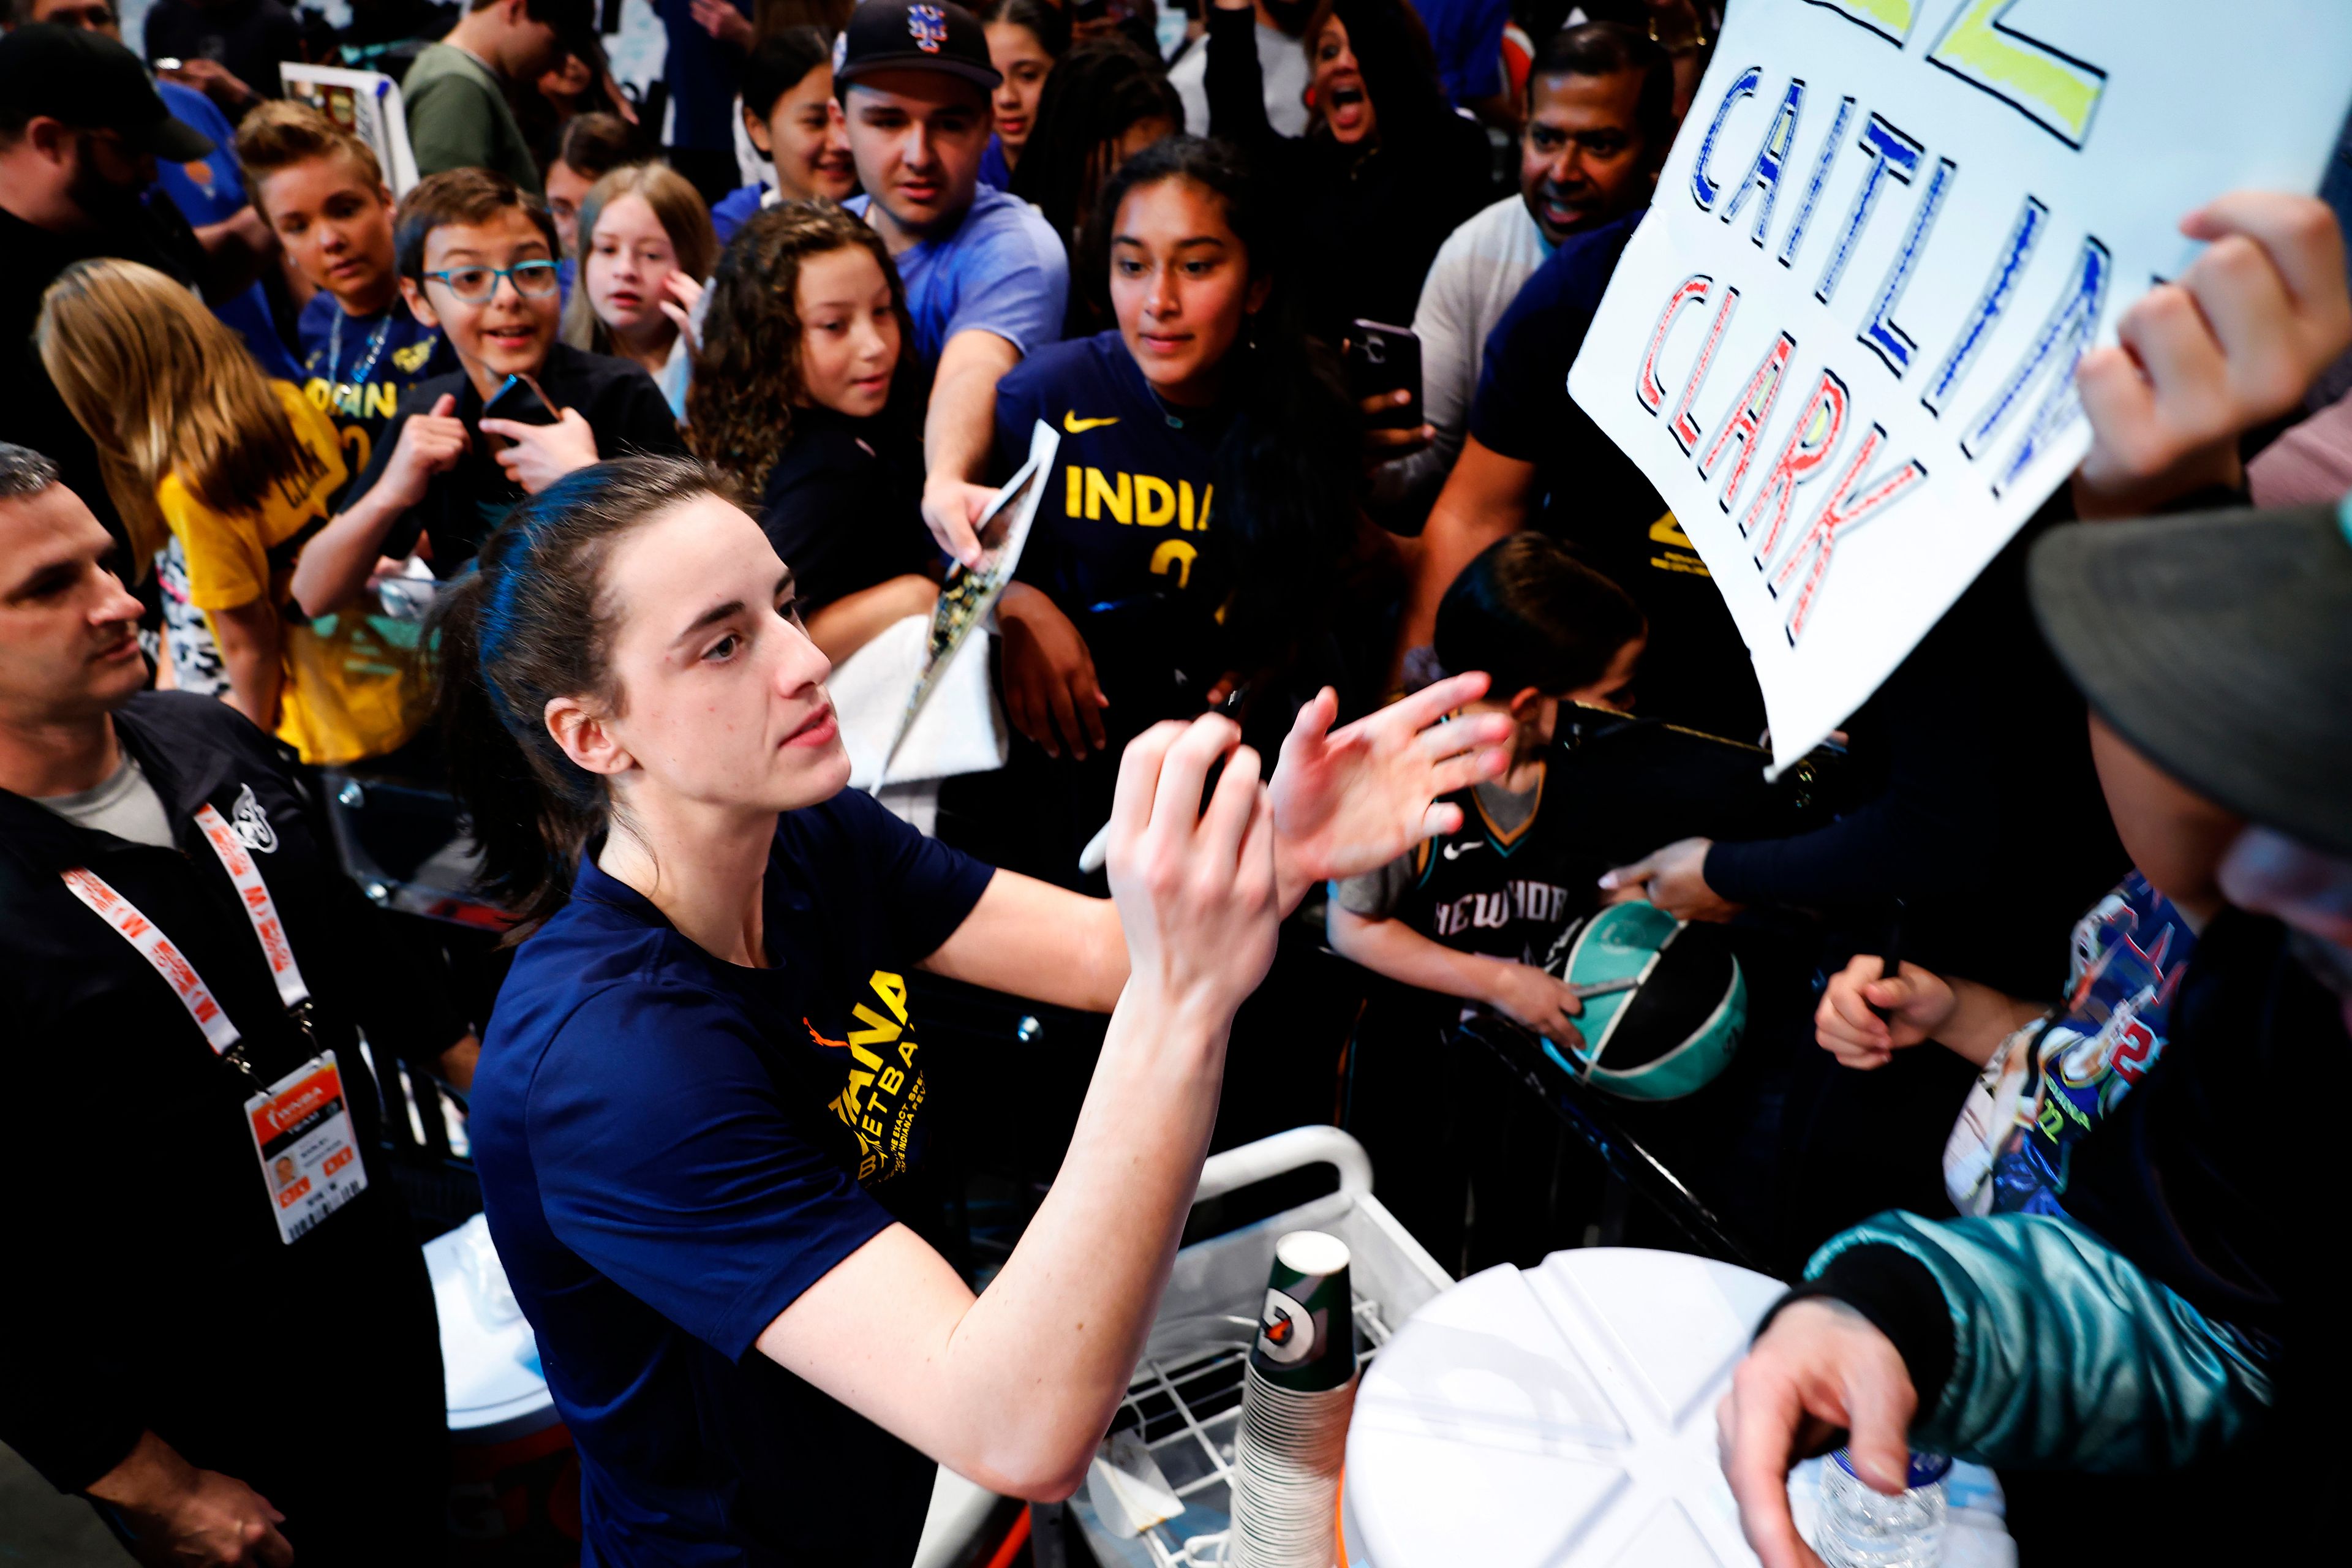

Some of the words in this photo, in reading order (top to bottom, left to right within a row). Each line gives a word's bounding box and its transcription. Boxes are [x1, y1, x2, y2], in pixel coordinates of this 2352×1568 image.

[1690, 66, 2111, 500] CAITLIN
[1635, 274, 1928, 647] CLARK
[892, 1102, 910, 1144] EXACT
[897, 1113, 914, 1152] INDIANA
